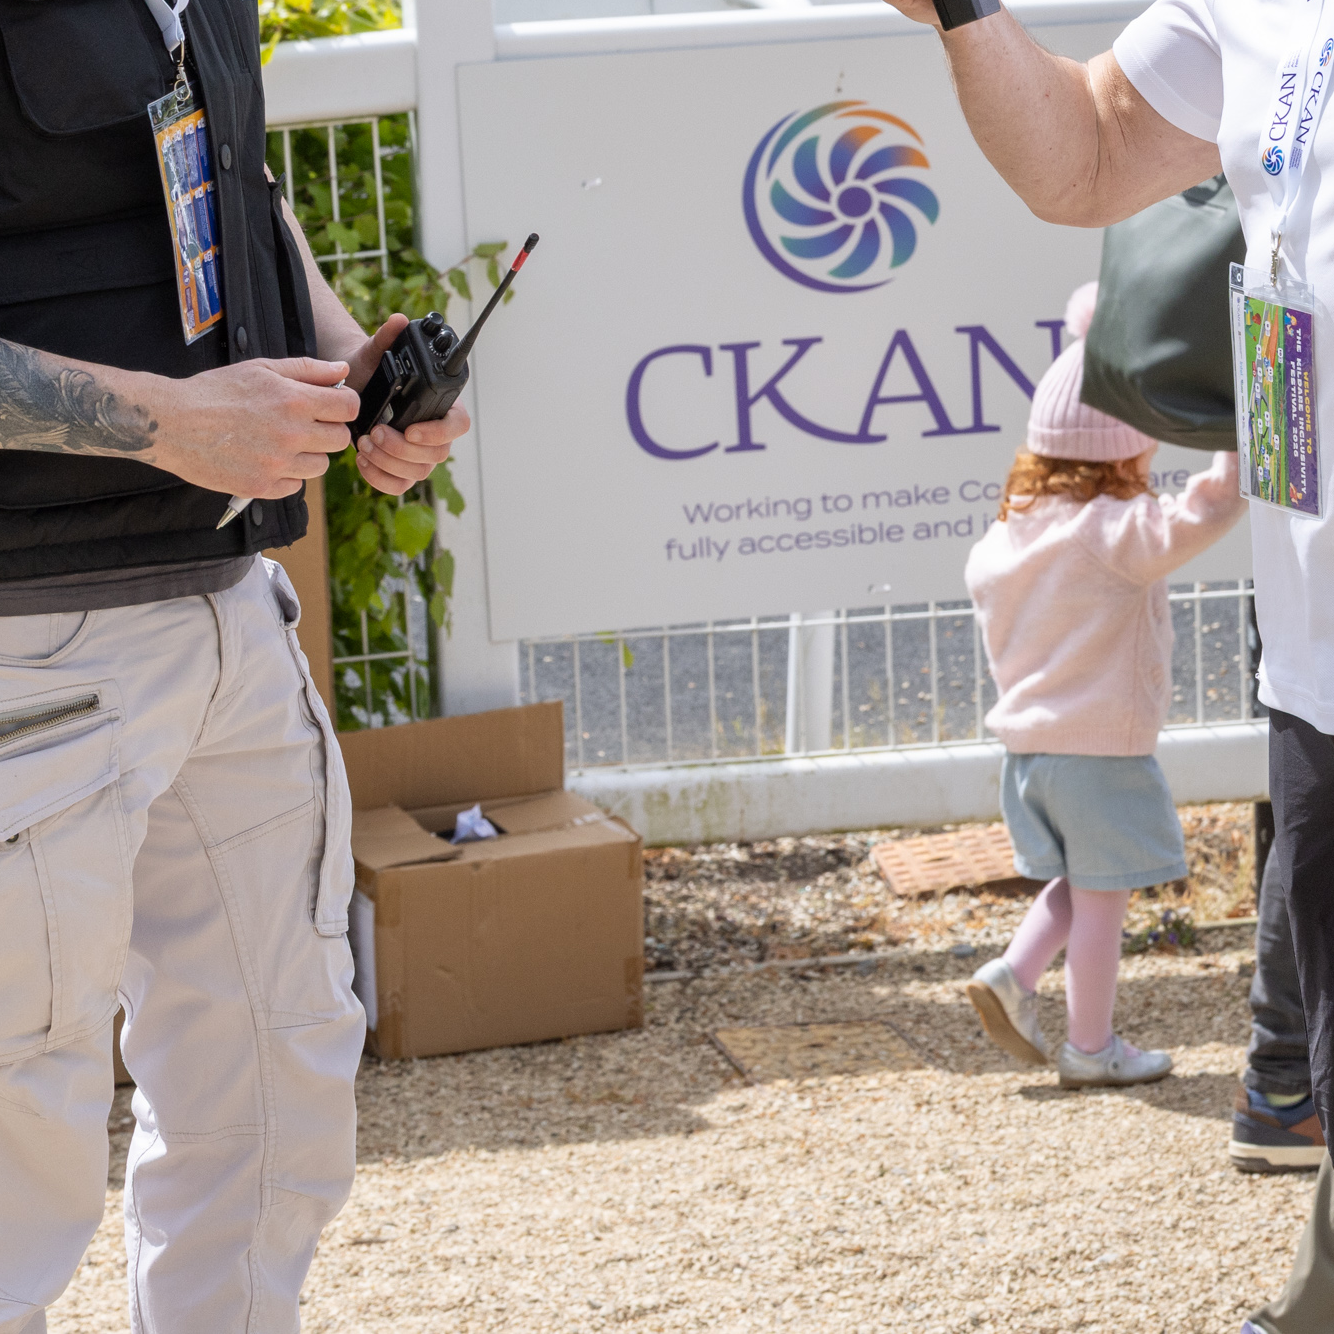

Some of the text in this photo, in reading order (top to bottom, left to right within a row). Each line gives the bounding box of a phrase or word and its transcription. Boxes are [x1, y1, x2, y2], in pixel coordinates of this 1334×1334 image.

[1268, 71, 1297, 141] CKAN
[1296, 71, 1324, 145] CKAN
[625, 319, 1065, 461] CKAN
[1296, 357, 1304, 412] KILDARE
[1303, 371, 1313, 455] WELCOME TO
[1298, 416, 1307, 494] INCLUSIVITY
[665, 534, 730, 562] fully
[737, 521, 905, 555] accessible
[912, 514, 973, 540] and
[683, 495, 813, 525] Working
[820, 491, 854, 513] to
[862, 483, 951, 509] make
